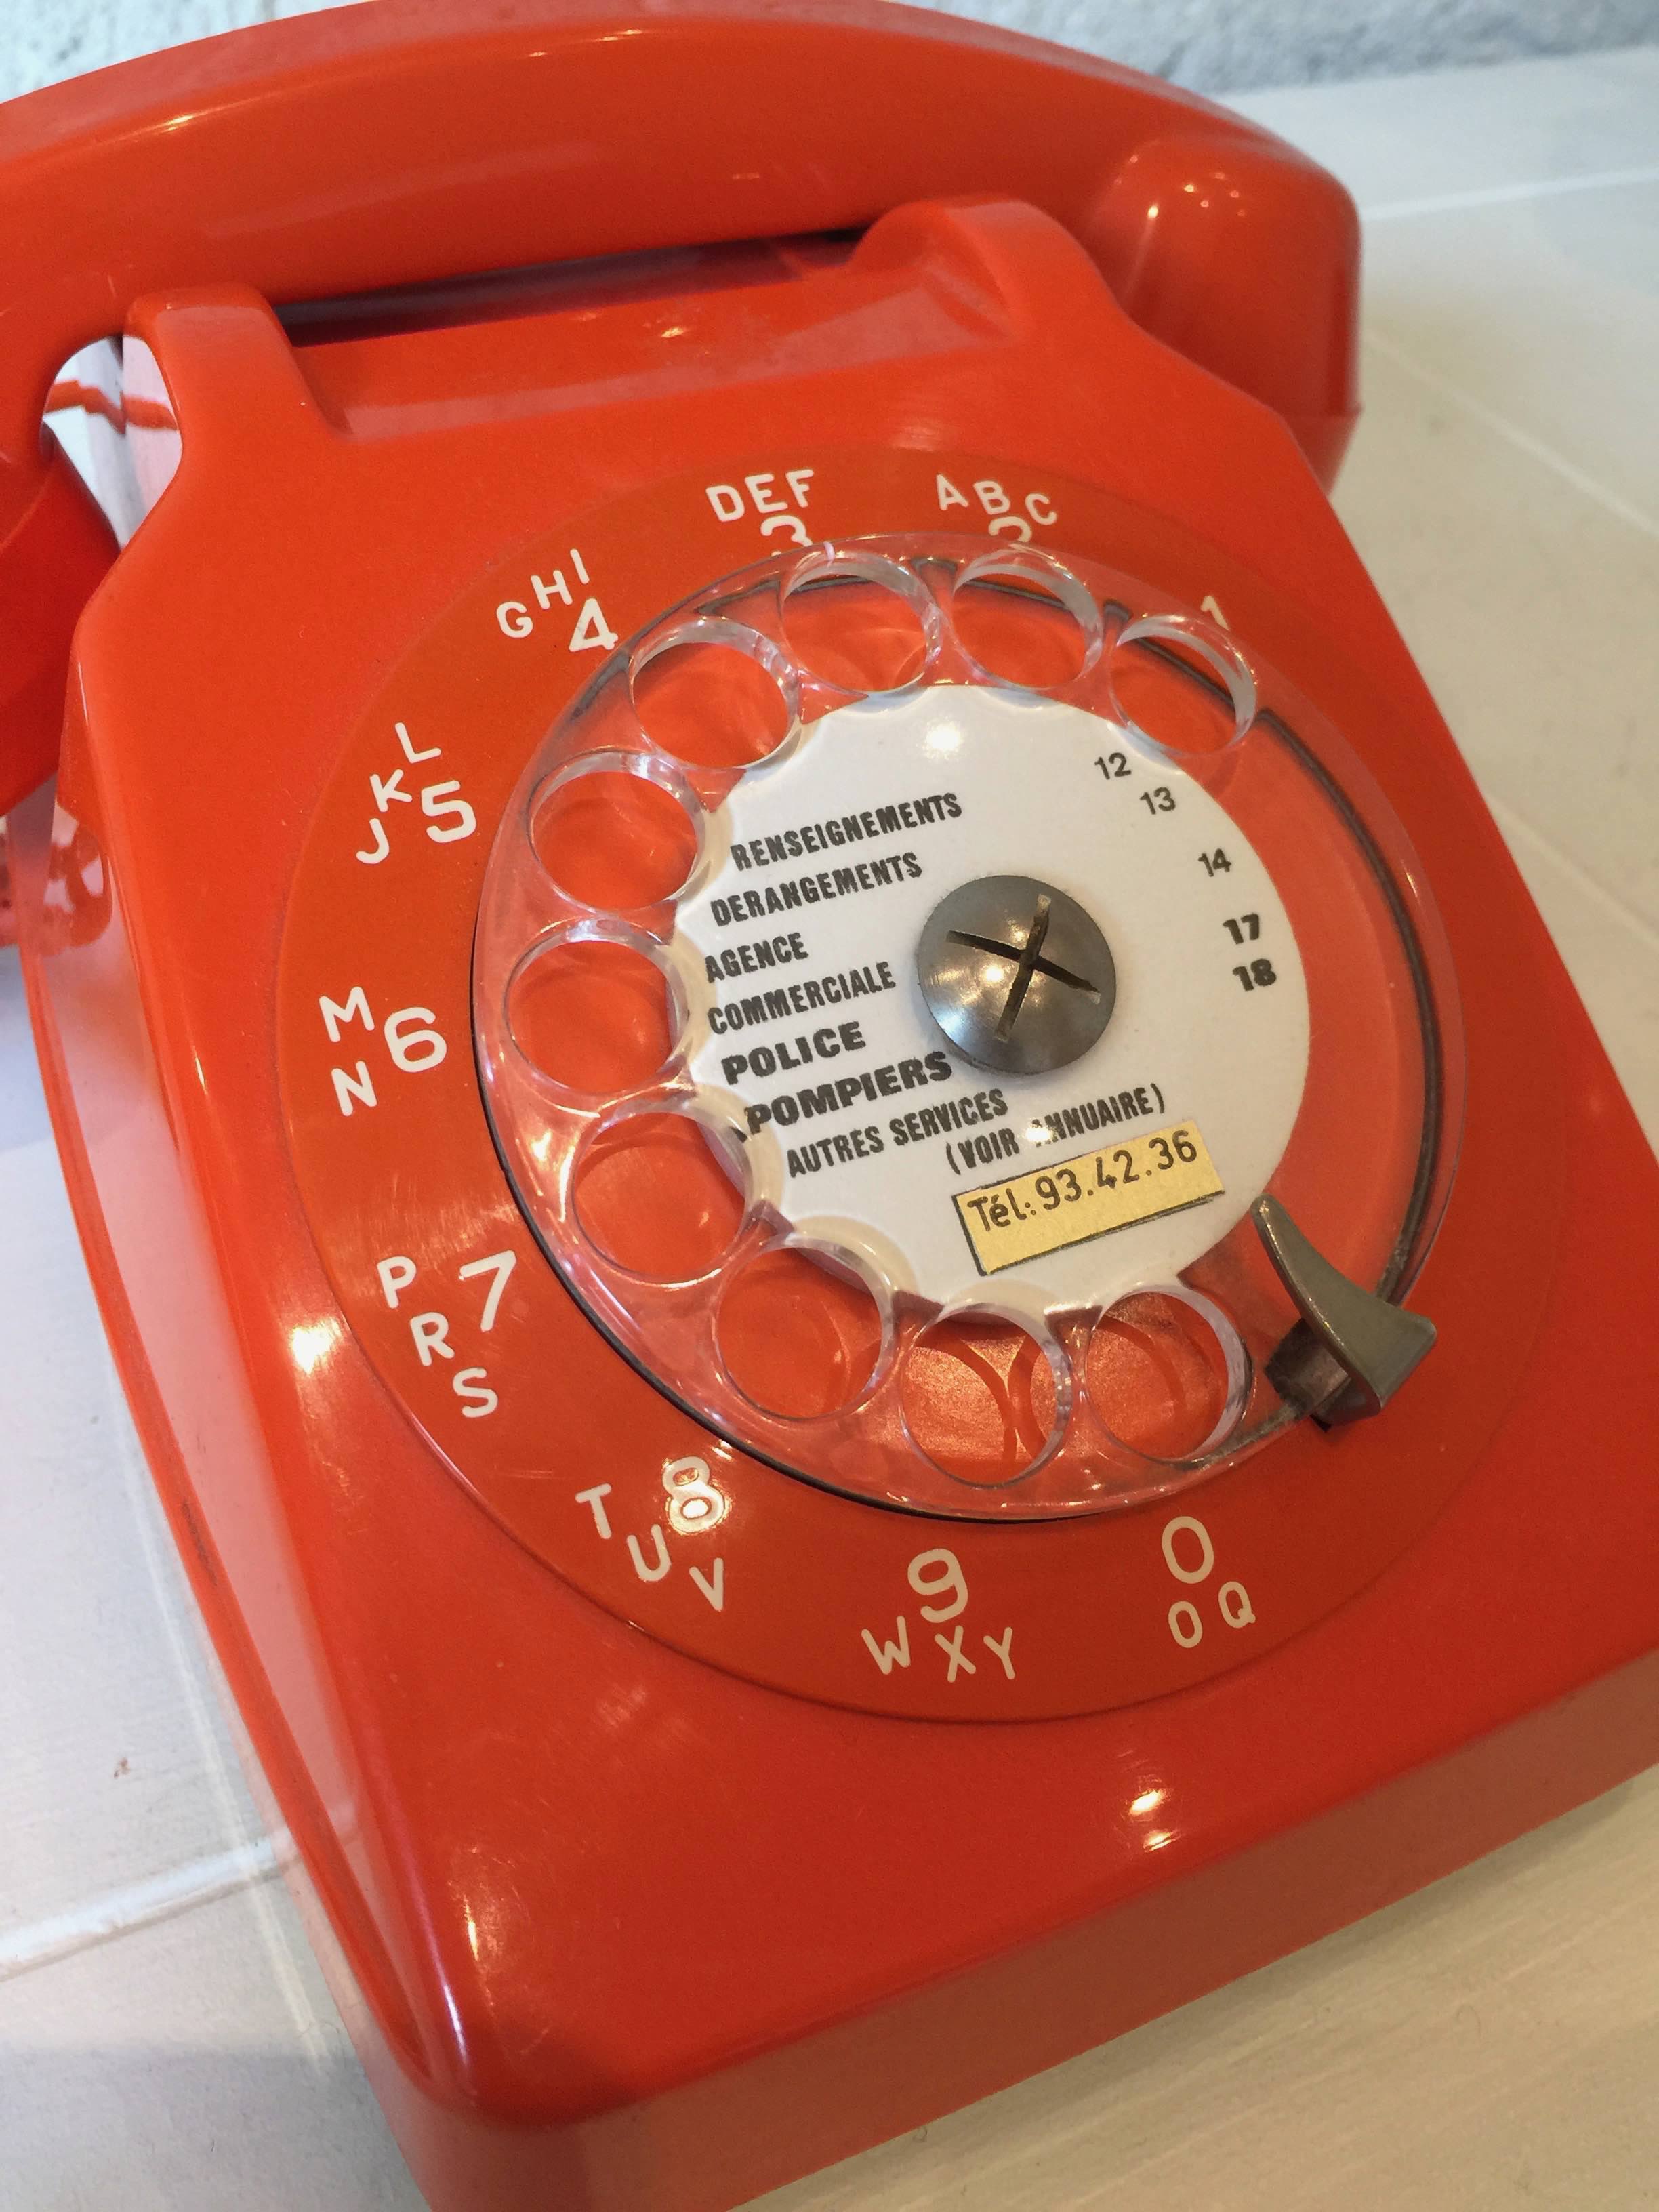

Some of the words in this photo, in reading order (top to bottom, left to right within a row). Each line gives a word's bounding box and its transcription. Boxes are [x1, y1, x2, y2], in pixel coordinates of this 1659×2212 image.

[569, 598, 619, 652] 4
[1094, 752, 1132, 780] 12
[421, 780, 477, 843] 5
[731, 792, 962, 872] RENSEIGNEMENTS
[1140, 787, 1176, 815] 13
[710, 852, 922, 926] DERANGEMENTS
[1197, 848, 1231, 877] 14
[705, 932, 808, 983] AGENCE
[1223, 913, 1261, 945] 17
[707, 961, 896, 1035] COMMERCIALE
[1232, 958, 1277, 991] 18
[384, 1006, 447, 1073] 6
[721, 1021, 866, 1085] POLICE
[744, 1051, 953, 1135] POMPIERS
[787, 1126, 884, 1178] AUTRES
[889, 1088, 1008, 1145] SERVICES
[945, 1127, 1020, 1175] (VOIR
[1031, 1082, 1166, 1147] NNUAIRE)
[459, 1250, 517, 1333] 7
[661, 1456, 730, 1535] 8
[1161, 1515, 1215, 1584] 0
[907, 1548, 968, 1624] 9
